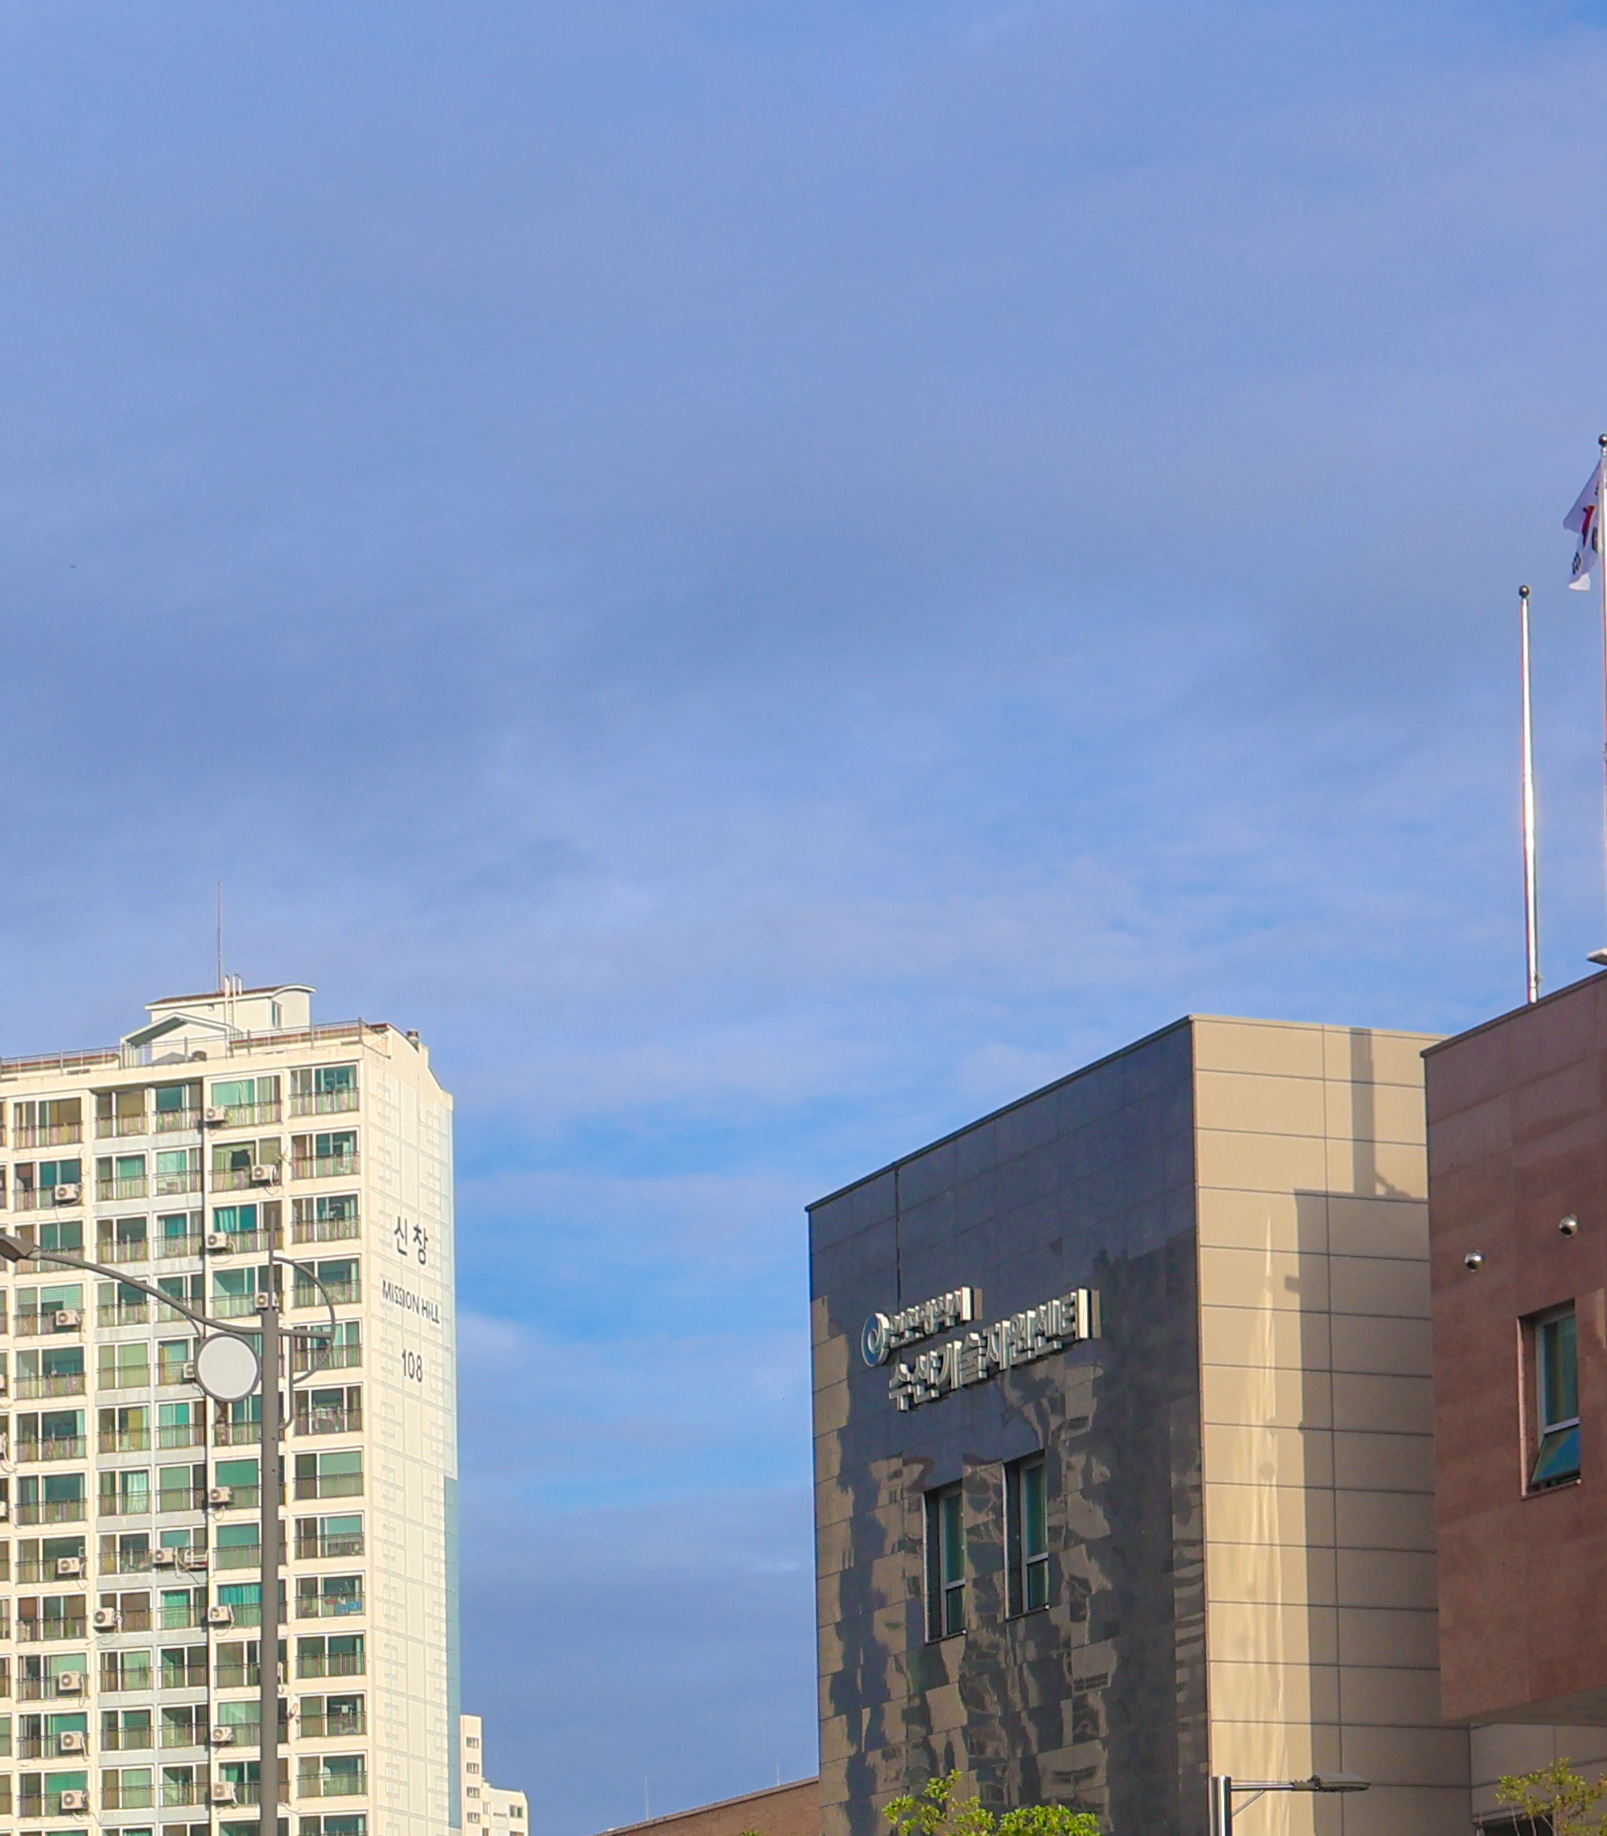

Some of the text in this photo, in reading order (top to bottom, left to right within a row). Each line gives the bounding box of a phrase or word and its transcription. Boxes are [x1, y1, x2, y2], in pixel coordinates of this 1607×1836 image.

[393, 1215, 429, 1265] 신창
[381, 1279, 420, 1317] MISSION
[401, 1348, 423, 1383] 108
[889, 1288, 1089, 1411] 수산기술지원센터
